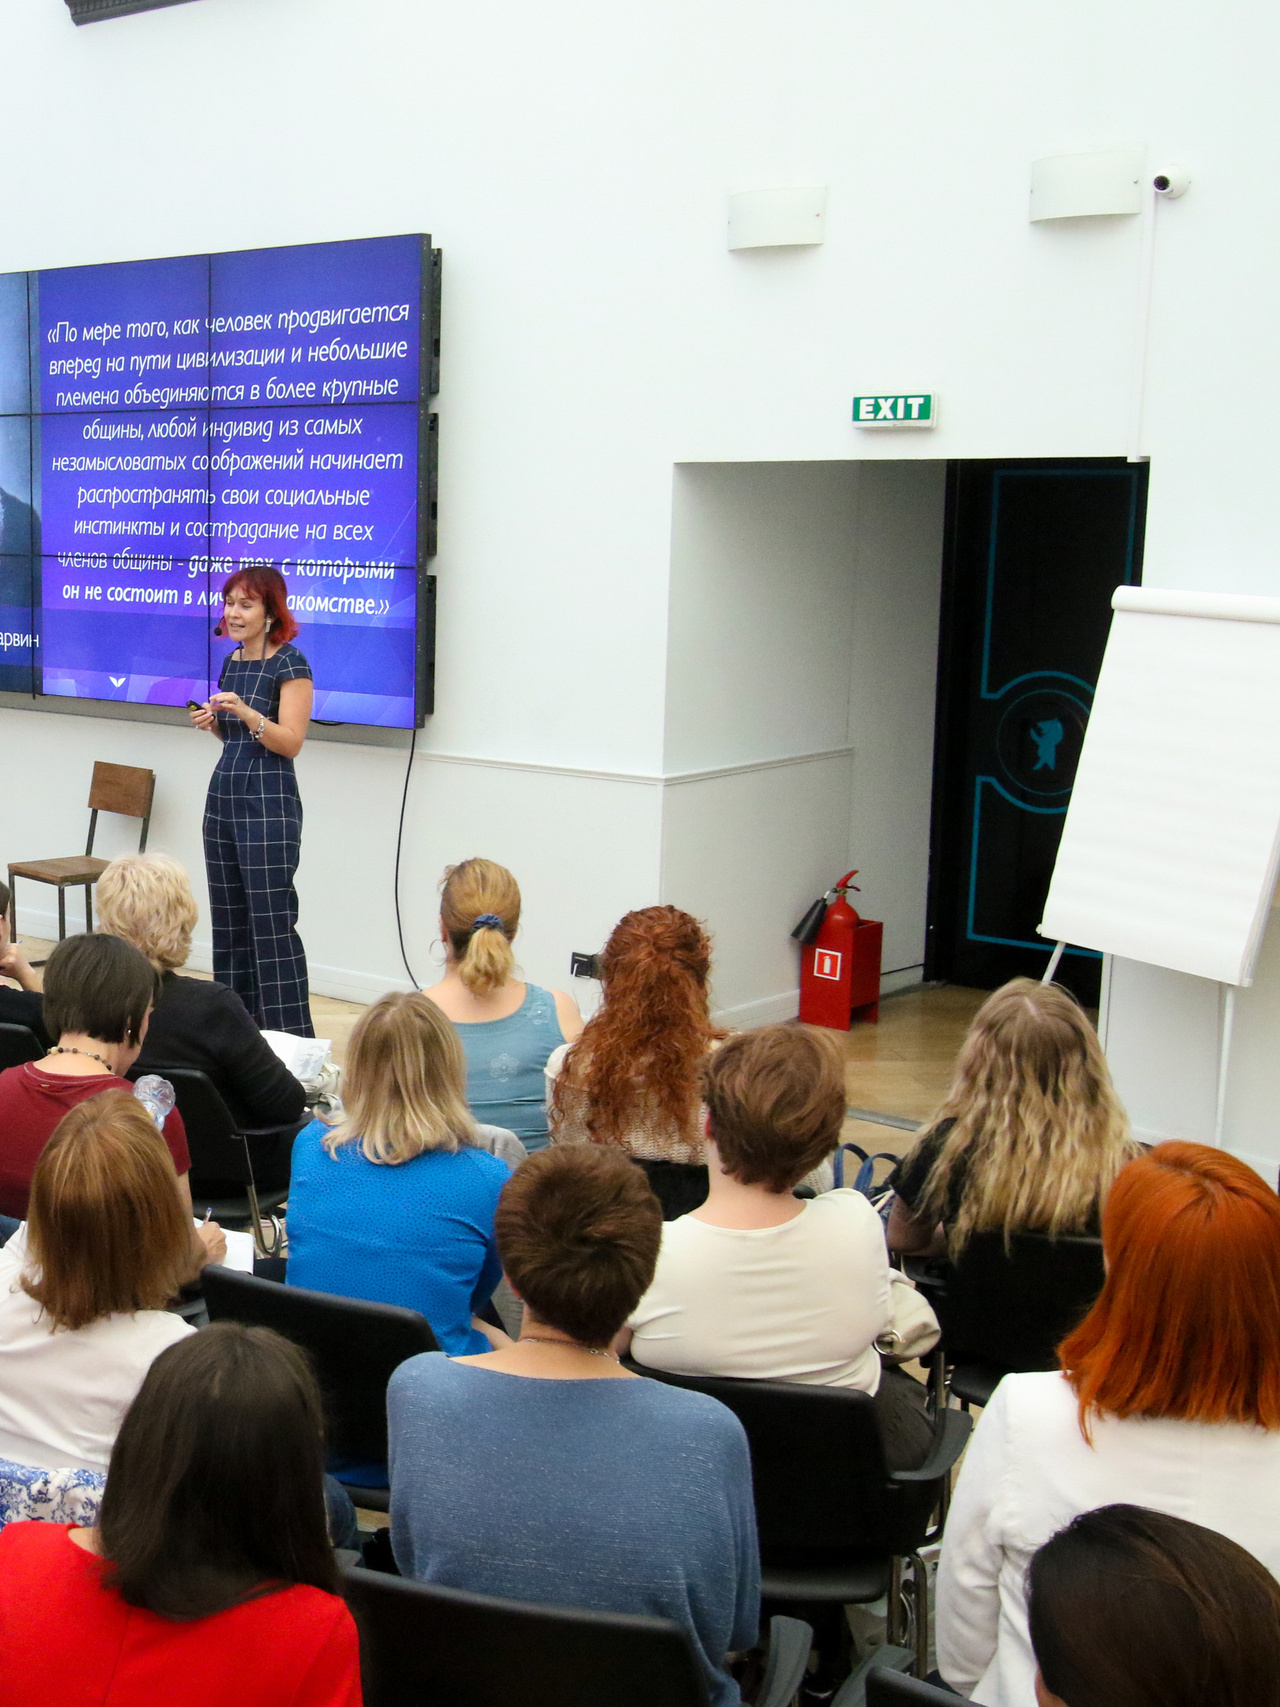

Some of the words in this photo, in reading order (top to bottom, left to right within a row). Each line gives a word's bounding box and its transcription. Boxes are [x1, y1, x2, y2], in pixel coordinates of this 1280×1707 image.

[48, 321, 77, 343] «По
[82, 322, 121, 346] мере
[126, 320, 169, 339] того,
[173, 318, 200, 335] как
[205, 313, 272, 333] человек
[278, 304, 410, 335] продвигается
[49, 357, 101, 379] вперед
[106, 356, 125, 372] на
[130, 353, 171, 377] пути
[176, 348, 285, 370] цивилизации
[291, 347, 302, 363] и
[308, 337, 408, 362] небольшие
[56, 389, 119, 406] племена
[124, 382, 244, 409] объединяются
[250, 384, 260, 400] в
[266, 376, 316, 399] более
[322, 378, 399, 404] крупные
[858, 397, 925, 420] EXIT
[83, 418, 144, 441] общины,
[147, 416, 197, 438] любой
[202, 419, 273, 443] индивид
[279, 419, 298, 436] из
[304, 418, 363, 435] самых
[52, 455, 187, 471] незамысловатых
[192, 448, 304, 477] соображений
[309, 453, 403, 470] начинает
[77, 486, 216, 510] распространять
[221, 488, 259, 505] свои
[265, 489, 370, 507] социальные
[74, 519, 165, 536] инстинкты
[170, 521, 180, 536] и
[185, 520, 299, 544] сострадание
[305, 523, 327, 540] на
[333, 523, 375, 541] всех
[57, 551, 107, 568] членов
[112, 547, 173, 572] общины
[187, 555, 233, 578] даже
[281, 558, 291, 576] с
[296, 557, 395, 584] которыми
[62, 584, 80, 599] он
[84, 585, 103, 600] не
[106, 586, 178, 605] состоит
[183, 591, 192, 605] в
[286, 594, 390, 615] акомстве.»
